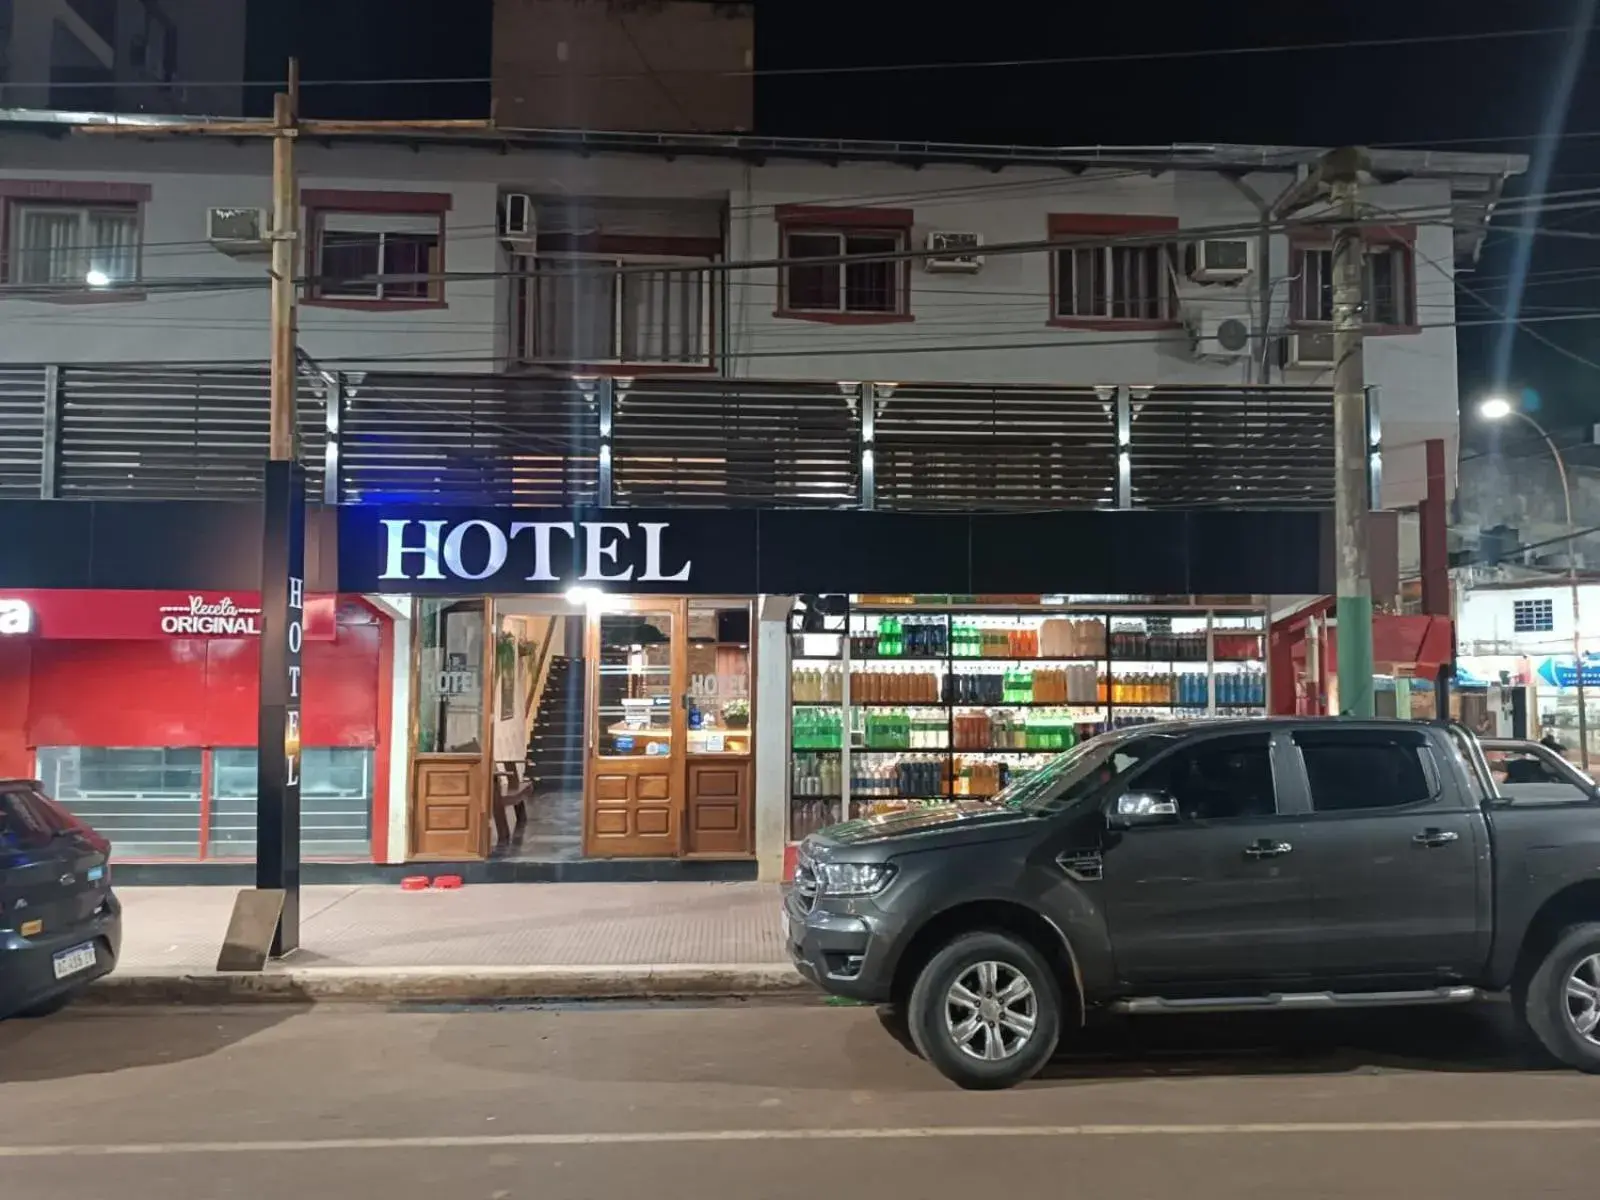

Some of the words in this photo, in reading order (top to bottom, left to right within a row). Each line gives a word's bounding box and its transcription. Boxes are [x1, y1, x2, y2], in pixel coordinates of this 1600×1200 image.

[377, 519, 692, 581] HOTEL
[188, 595, 239, 617] Receta
[161, 615, 261, 634] ORIGINAL
[286, 577, 303, 786] HOTEL
[691, 674, 748, 695] HOEL
